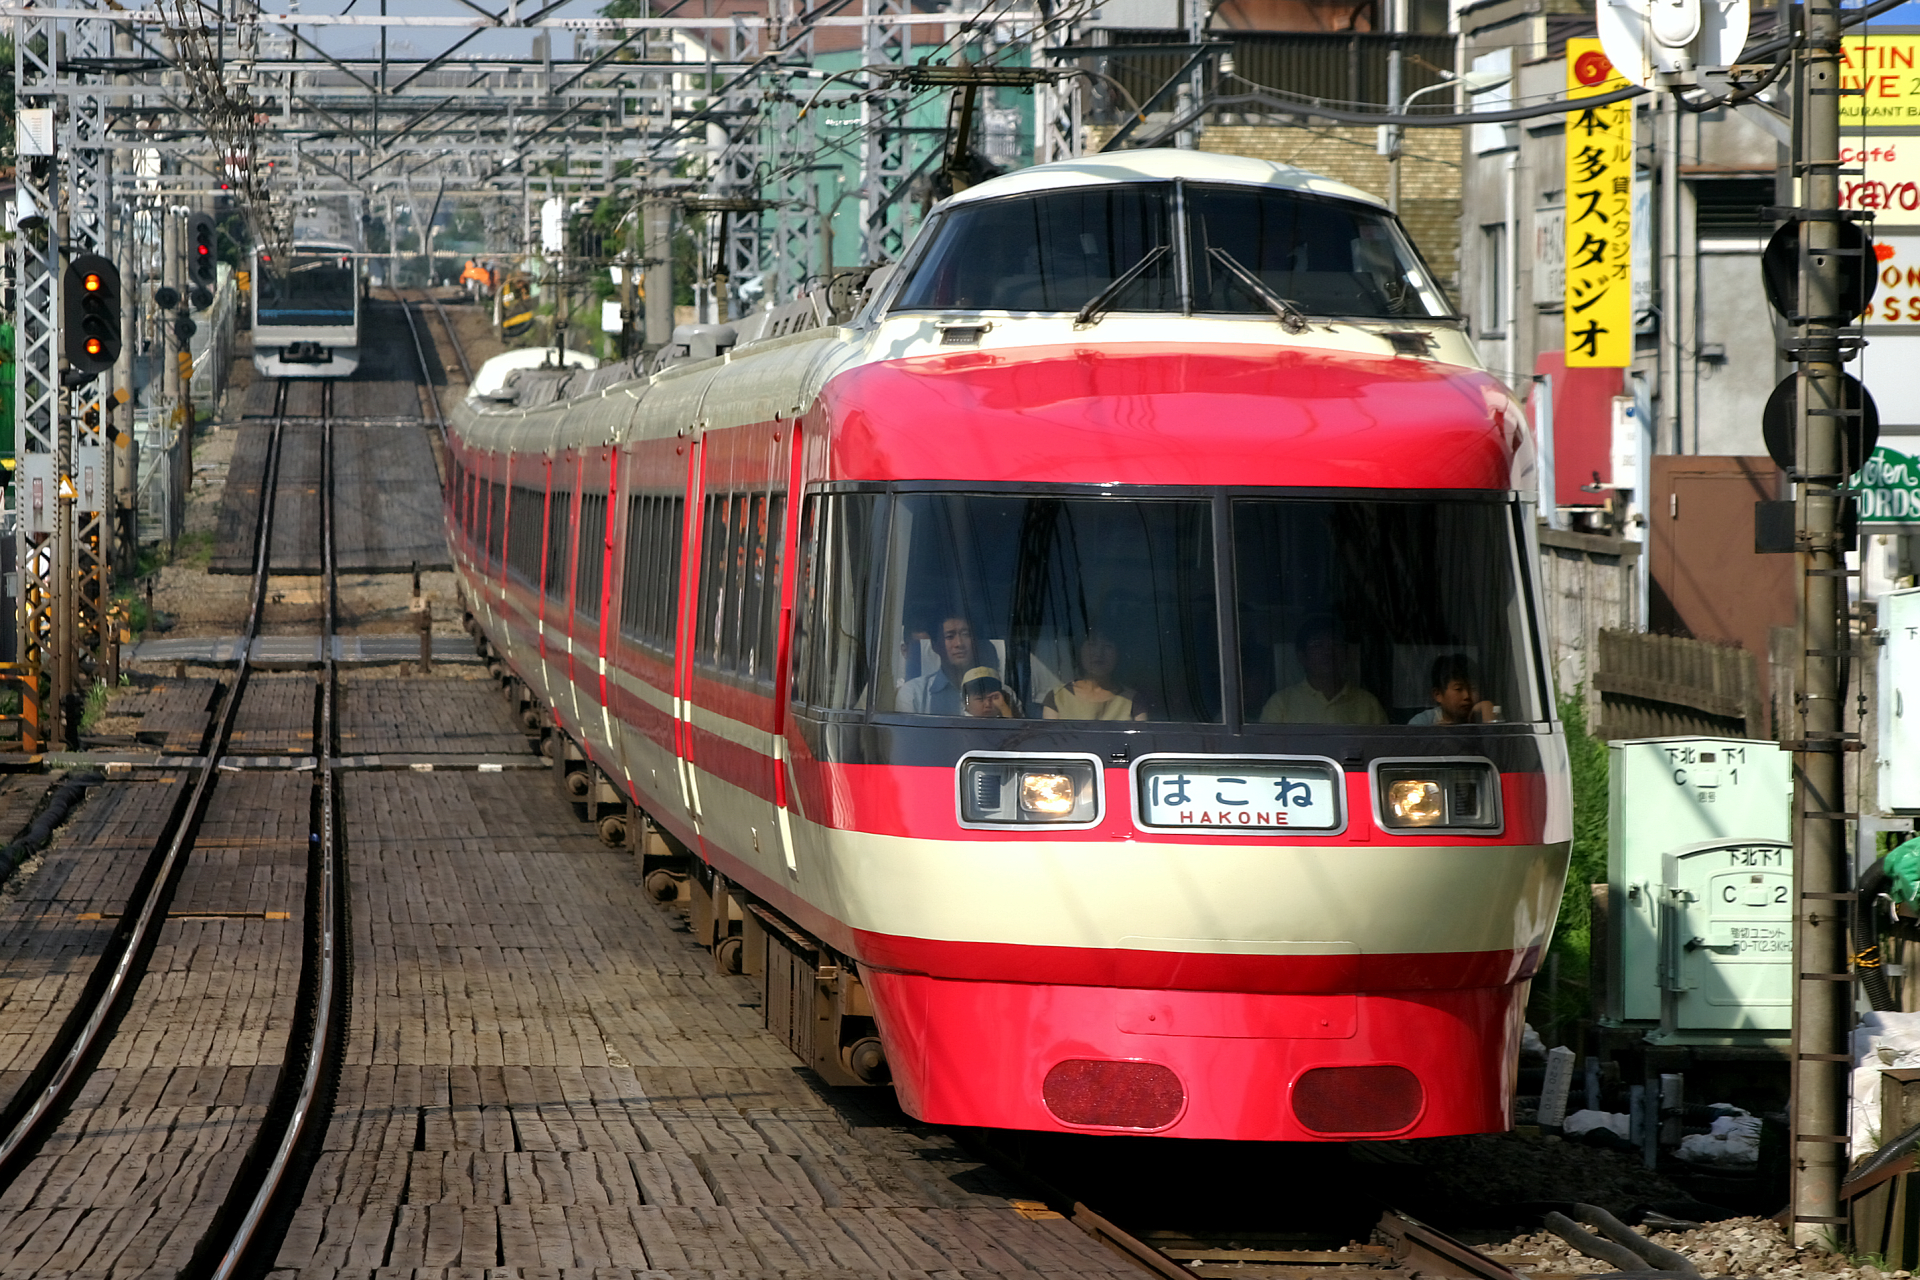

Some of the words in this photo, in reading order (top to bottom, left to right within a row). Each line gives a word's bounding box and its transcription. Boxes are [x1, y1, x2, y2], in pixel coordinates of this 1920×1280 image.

[1839, 46, 1914, 69] ATIN
[1839, 75, 1901, 98] IVE
[1840, 106, 1903, 117] AURANT
[1613, 82, 1632, 163] ホール
[1839, 144, 1896, 162] Café
[1838, 180, 1920, 211] ravo
[1852, 488, 1920, 518] ORDS
[1664, 747, 1696, 765] 下北
[1721, 747, 1746, 765] 下1
[1673, 768, 1688, 786] C
[1729, 768, 1738, 785] 1
[1152, 774, 1314, 807] はこね
[1180, 810, 1289, 825] HAKONE
[1725, 848, 1783, 867] 下北下1
[1722, 885, 1737, 903] C
[1774, 885, 1788, 903] 2
